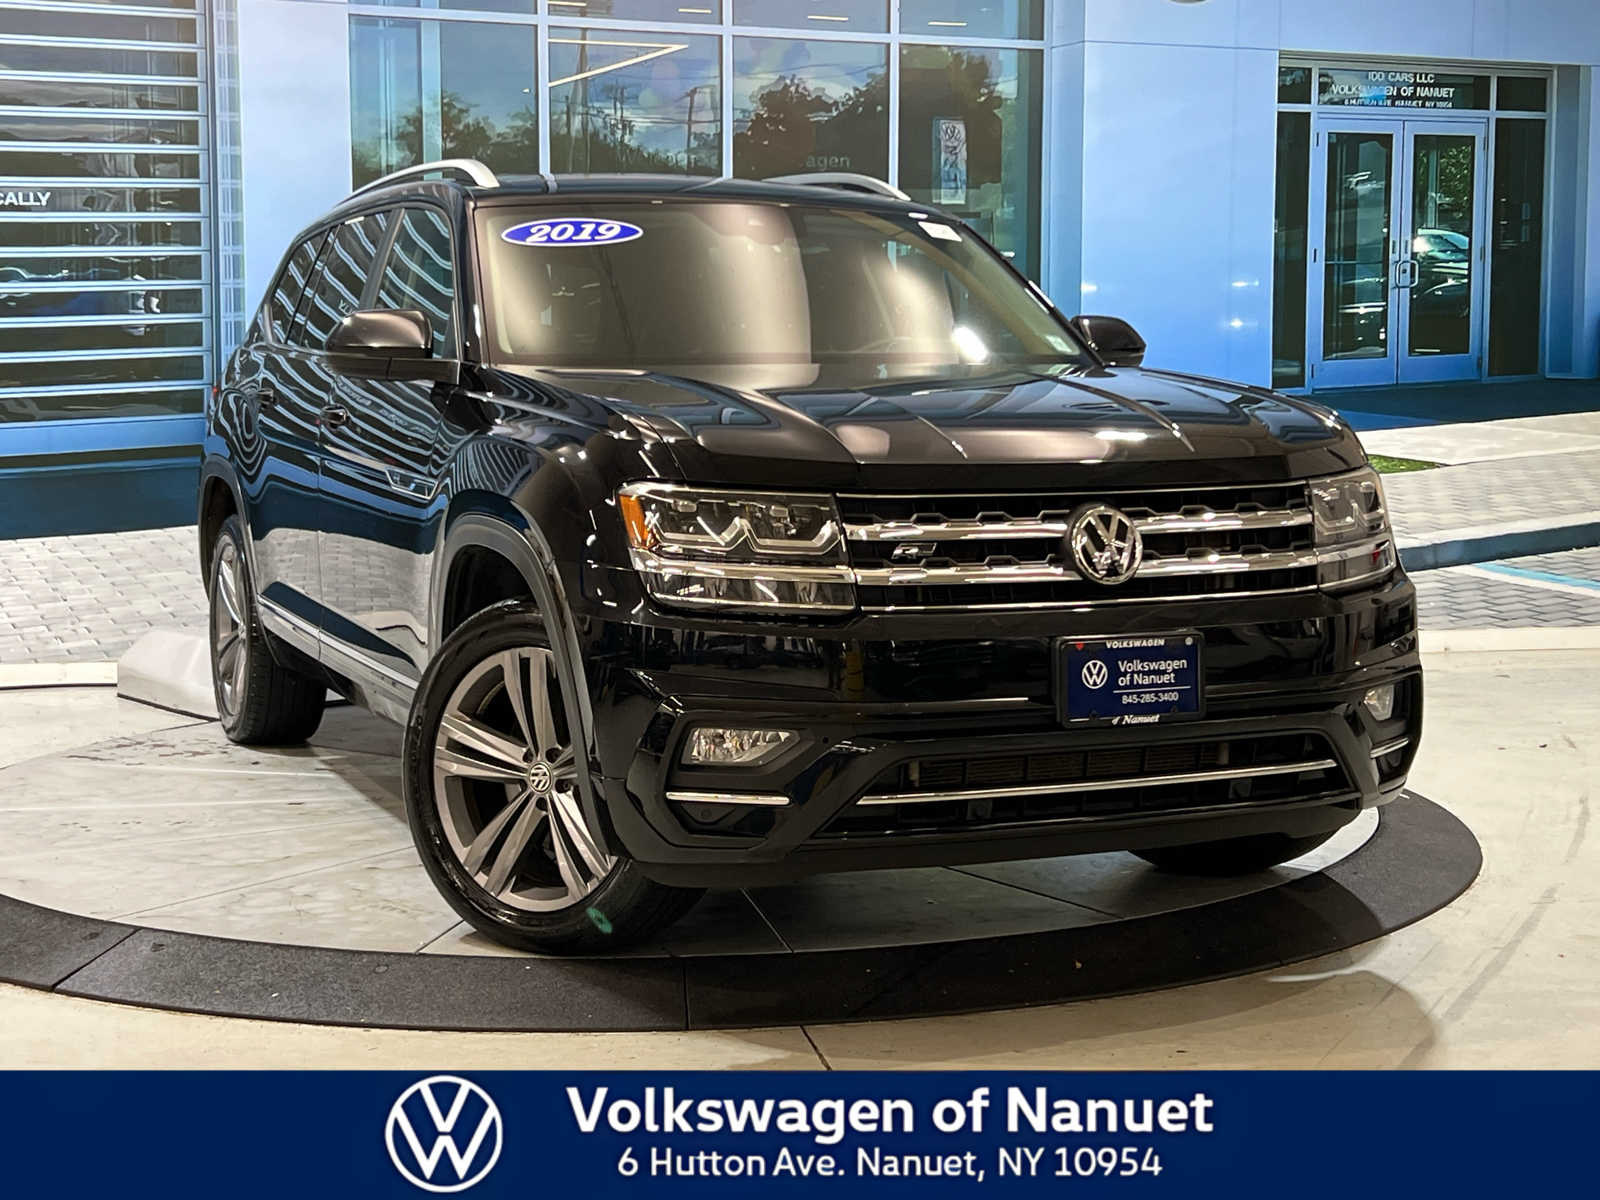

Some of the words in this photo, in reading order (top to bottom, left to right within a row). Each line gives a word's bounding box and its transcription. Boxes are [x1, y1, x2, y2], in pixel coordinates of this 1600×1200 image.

[1388, 72, 1414, 83] CARS
[1416, 73, 1435, 84] LLC
[1400, 86, 1414, 97] OF
[1416, 86, 1455, 98] NANUET
[525, 223, 622, 243] 2019
[1106, 638, 1165, 649] VOLKSWAGEN
[1118, 659, 1187, 672] Volkswagen
[1118, 674, 1131, 686] of
[1133, 673, 1175, 686] Nanuet
